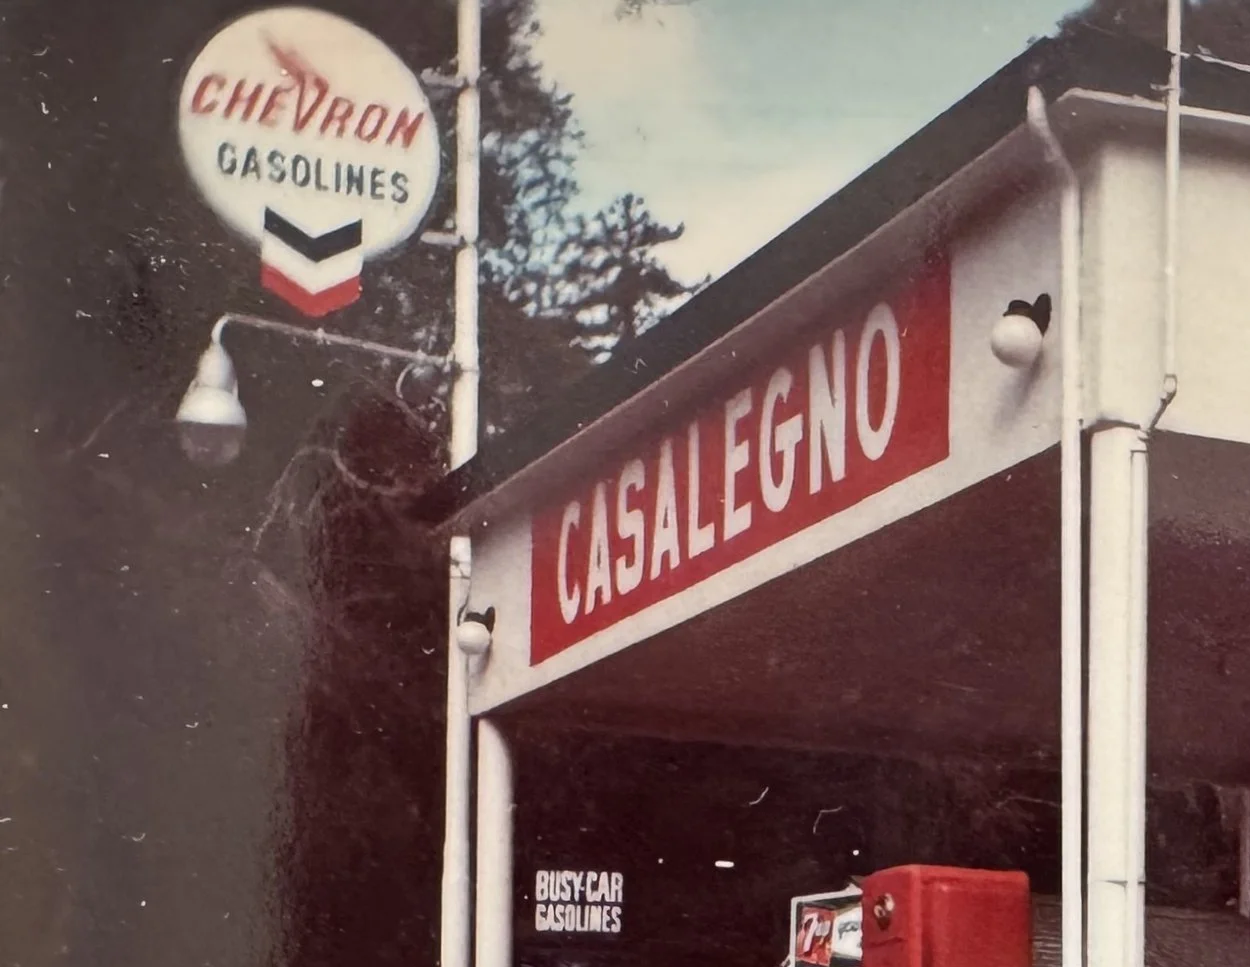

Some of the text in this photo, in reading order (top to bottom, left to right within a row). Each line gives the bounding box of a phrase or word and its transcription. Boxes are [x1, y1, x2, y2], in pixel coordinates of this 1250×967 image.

[190, 70, 424, 150] CHEVRON
[217, 141, 409, 204] GASOLINES
[557, 302, 901, 625] CASALEGNO
[535, 903, 623, 934] GASOLINES
